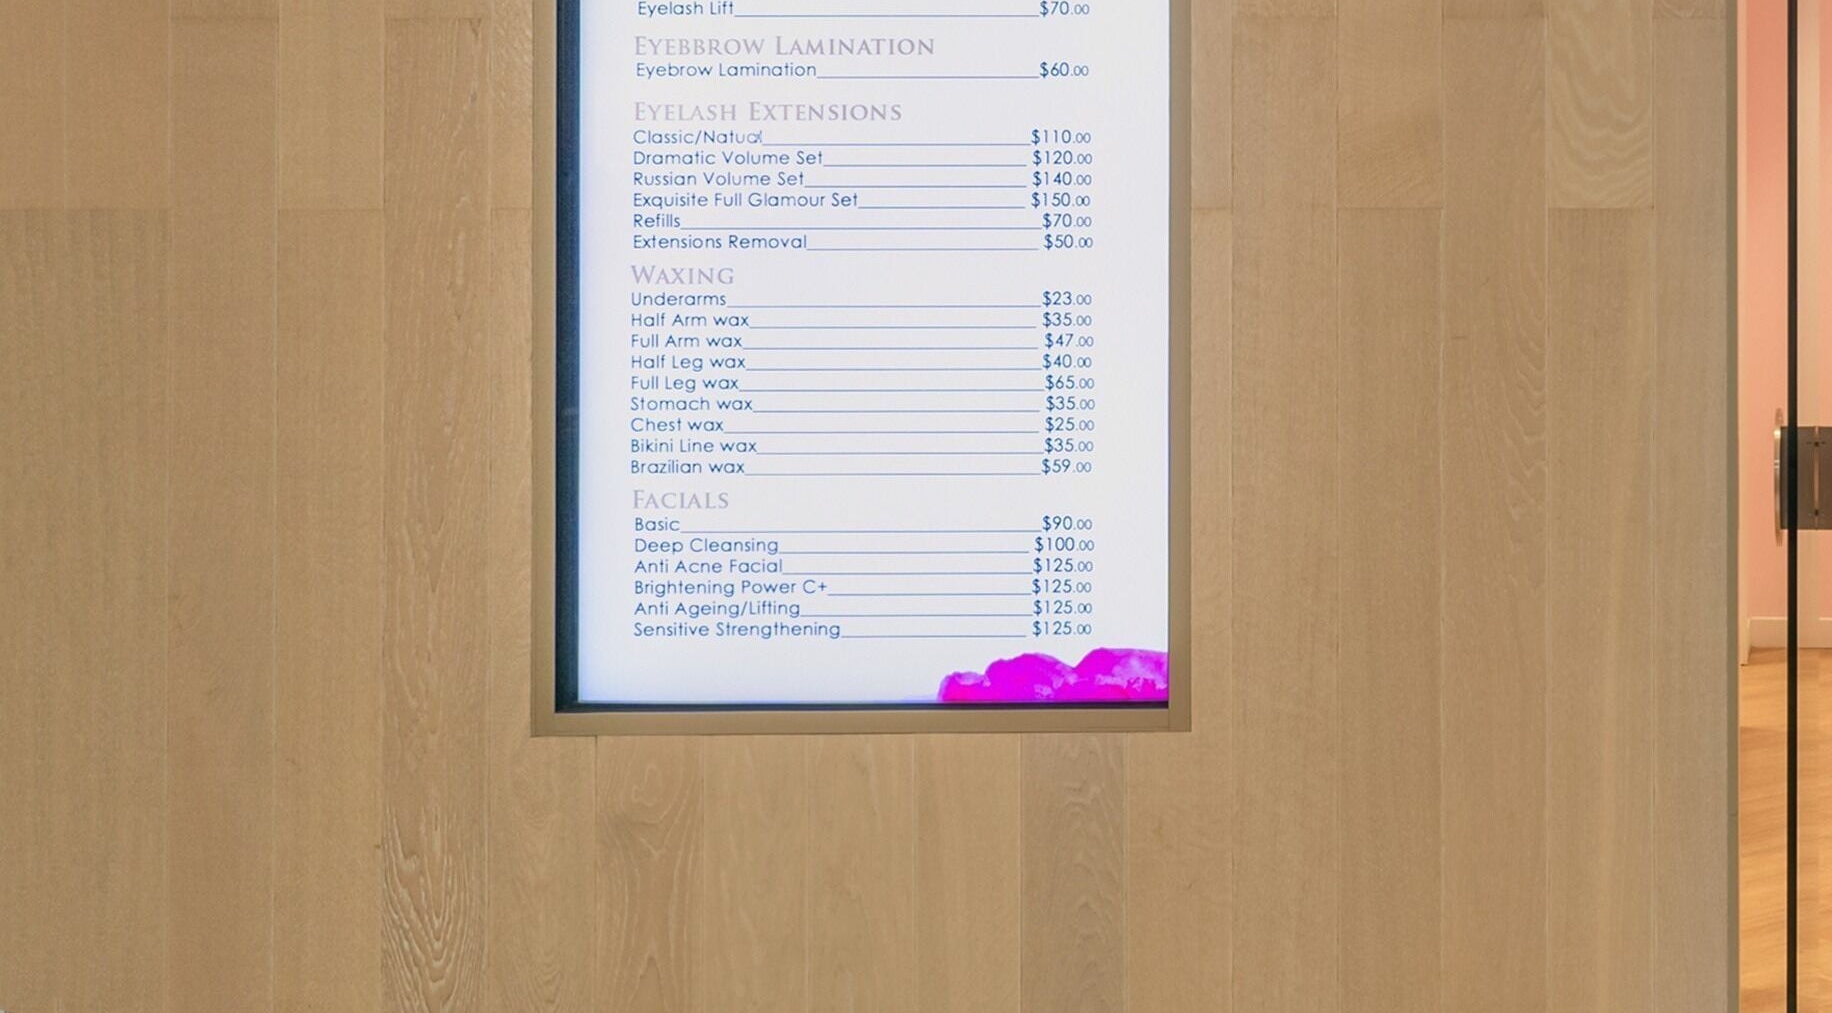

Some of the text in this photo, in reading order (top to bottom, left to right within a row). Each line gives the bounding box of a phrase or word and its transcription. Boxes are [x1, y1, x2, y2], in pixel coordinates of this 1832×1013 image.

[638, 0, 1090, 18] Eyelash Lift $70.00
[635, 36, 934, 55] EYEBBROW LAMINATION
[637, 61, 1089, 79] Eyebrow Lamination $60.00
[635, 102, 901, 121] EYELASH EXTENSIONS
[1031, 129, 1091, 146] $110.00
[634, 149, 1093, 167] Dramatic Volume Set $120.00
[634, 171, 1092, 188] Russian Volume Set $140.00
[633, 191, 1091, 209] Exquisite Full Glamour Set $150.00
[633, 212, 1092, 230] Refills $70.00
[633, 233, 1093, 251] Extensions Removal $50.00
[631, 265, 733, 284] WAXING
[632, 291, 1092, 308] Underarms $23.00
[631, 311, 1092, 329] Half Arm wax $35.00
[631, 332, 1094, 350] Full Arm wax $47.00
[631, 353, 1092, 372] Half Leg wax $40.00
[631, 374, 1095, 393] Full Leg wax $65.00
[630, 395, 1095, 413] Stomach wax $35.00
[630, 416, 1095, 434] Chest wax $25.00
[631, 437, 1094, 455] Bikini Line wax $35.00
[631, 458, 1092, 475] Brazilian wax $59.00
[633, 490, 728, 509] FACIALS
[635, 515, 1092, 533] Basic $90.00
[635, 536, 1095, 555] Deep Cleansing $100.00
[635, 557, 1093, 575] Anti Acne Facial $125.00
[635, 578, 1092, 598] Brightening Power C+ $125.00
[634, 599, 1093, 619] Anti Ageing/Lifting $125.00
[633, 620, 1092, 639] Sensitive Strengthening $125.00
